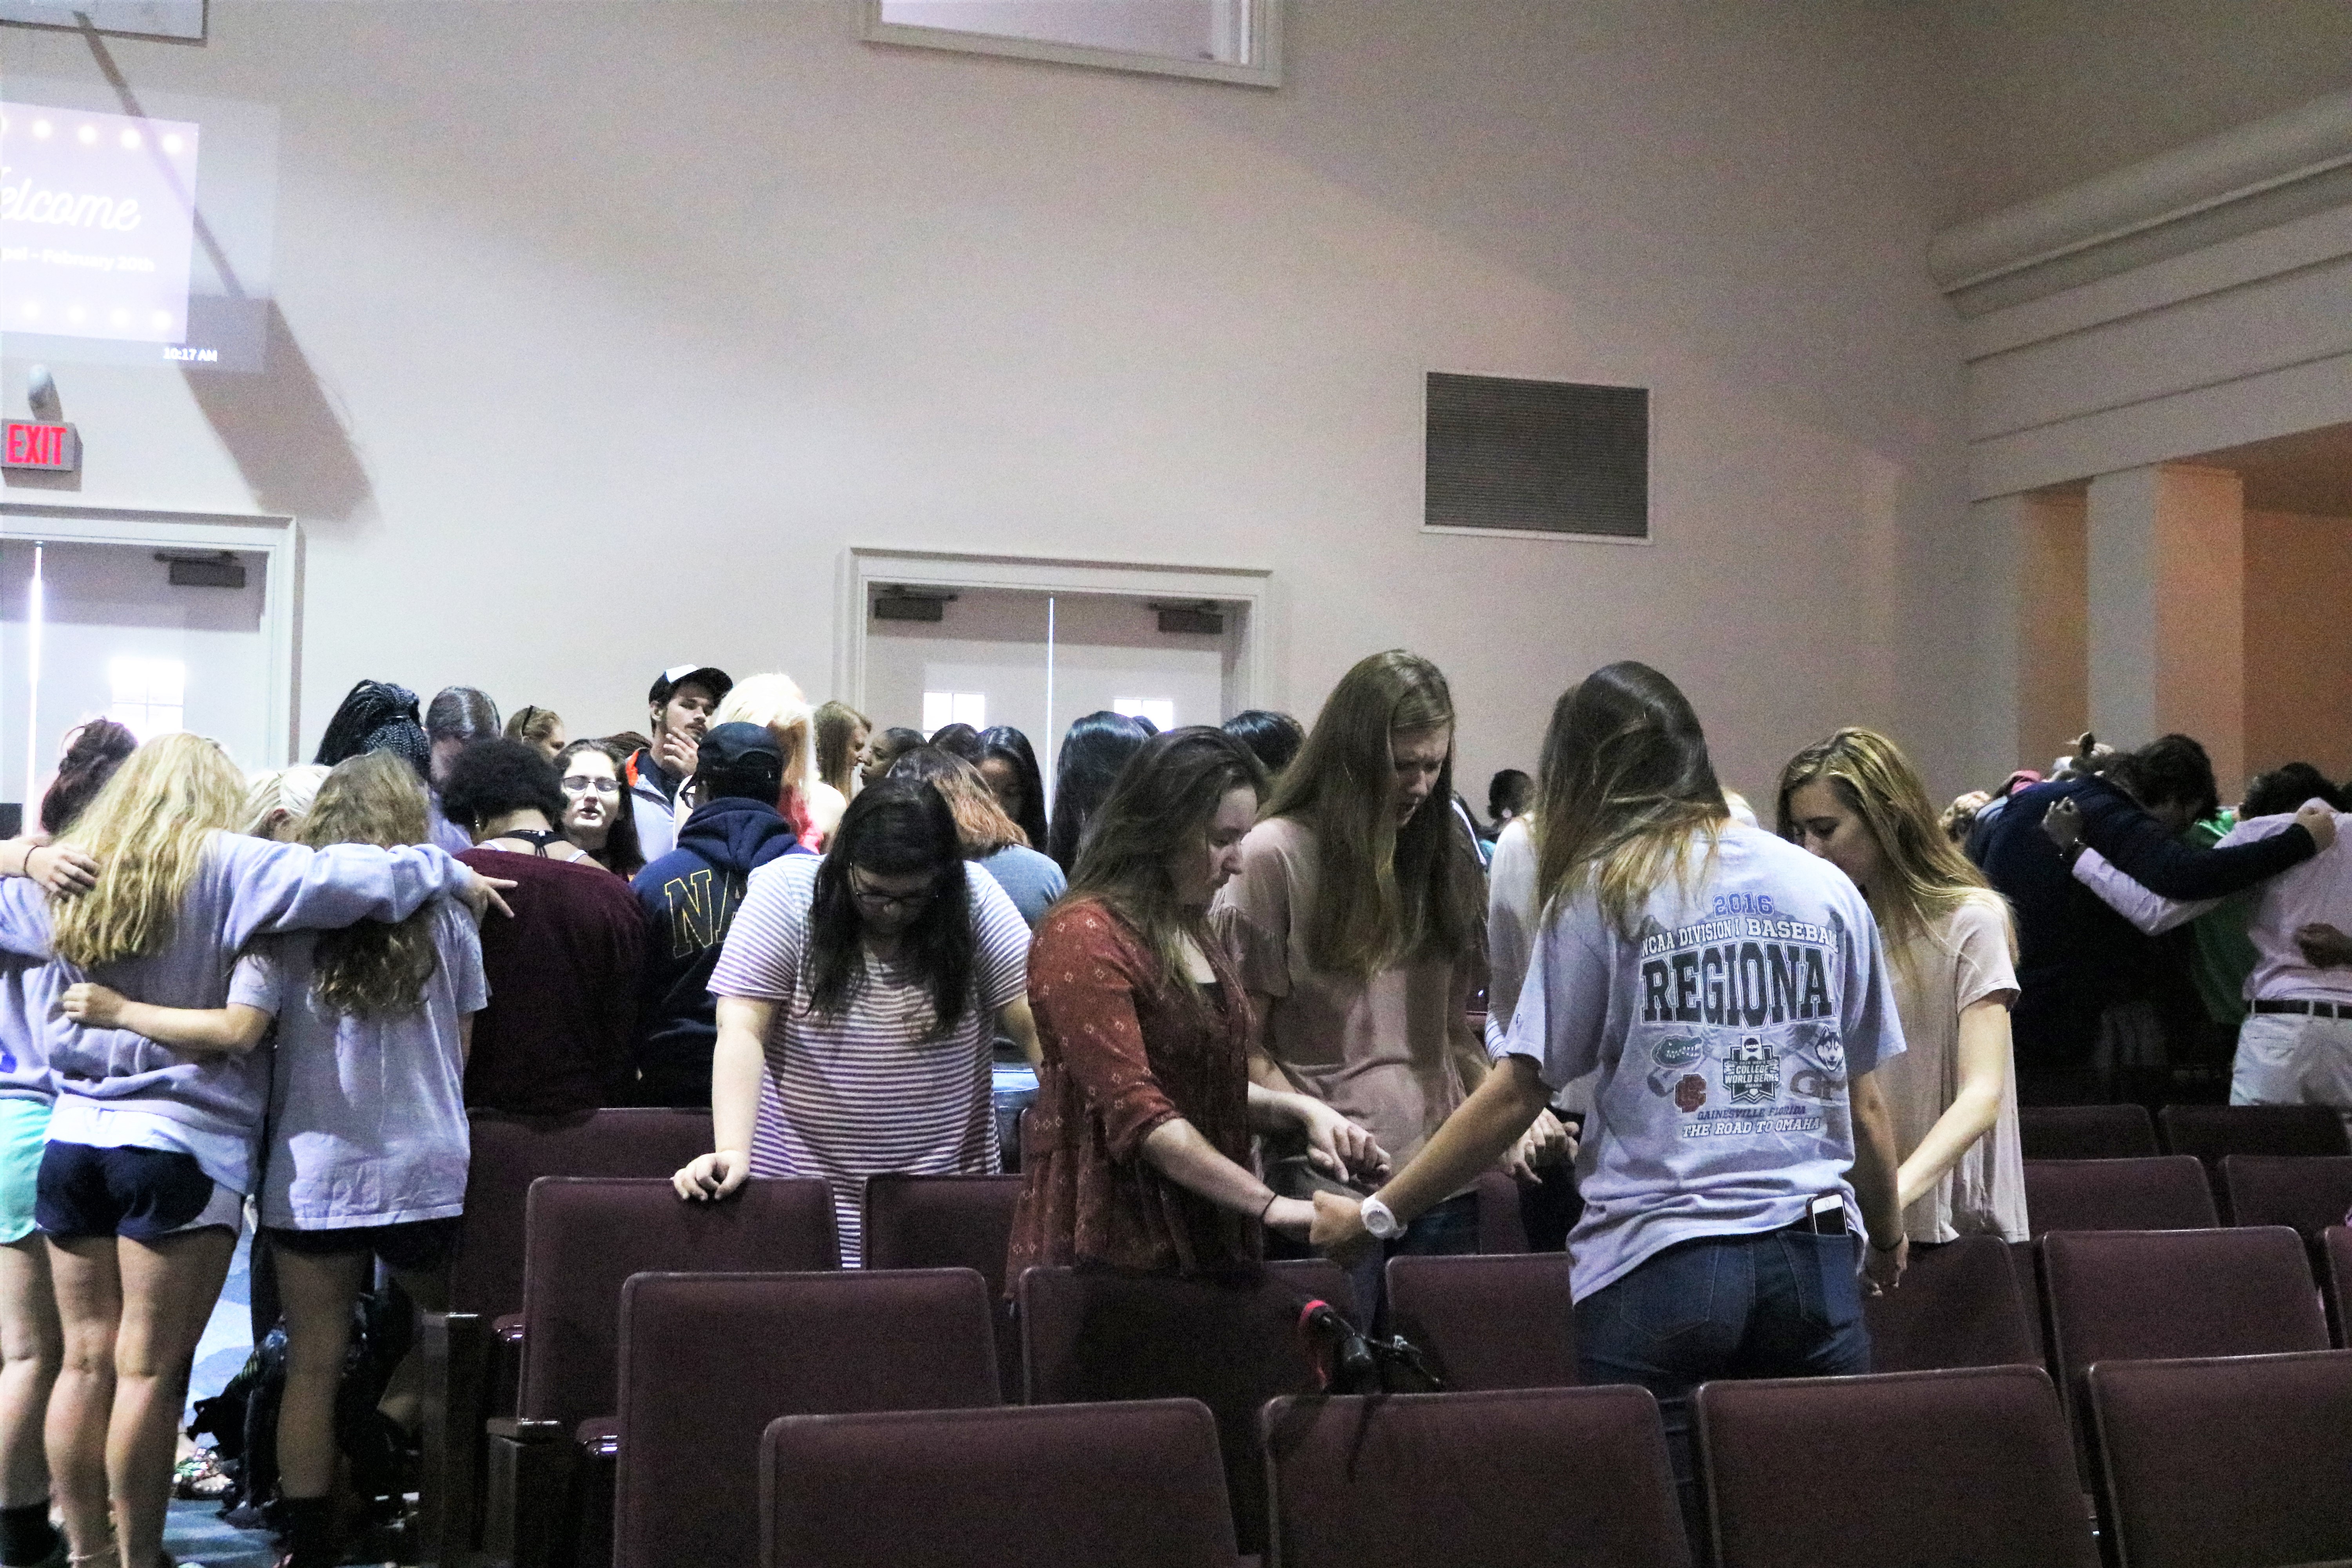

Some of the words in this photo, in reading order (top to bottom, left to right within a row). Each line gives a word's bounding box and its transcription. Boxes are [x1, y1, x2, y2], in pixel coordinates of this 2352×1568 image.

[0, 166, 142, 231] elcome
[0, 247, 28, 261] pel
[43, 249, 115, 271] February
[117, 256, 155, 272] 20th
[163, 348, 197, 361] 10:17
[198, 349, 218, 362] AM
[6, 423, 67, 466] EXIT
[1713, 891, 1775, 919] 2016
[1642, 931, 1675, 957] NCAA
[1678, 919, 1732, 947] DIVISION
[1734, 917, 1740, 936] I
[1725, 1074, 1753, 1084] WORLD
[1754, 1073, 1779, 1083] SERIES
[1736, 1065, 1769, 1074] COLLEGE
[1697, 1108, 1765, 1120] GAINESVILLE
[1768, 1105, 1806, 1116] FLORIDA
[1682, 1123, 1711, 1138] THE
[1715, 1121, 1753, 1135] ROAD
[1756, 1120, 1773, 1134] TO
[1775, 1117, 1821, 1131] OMAHA
